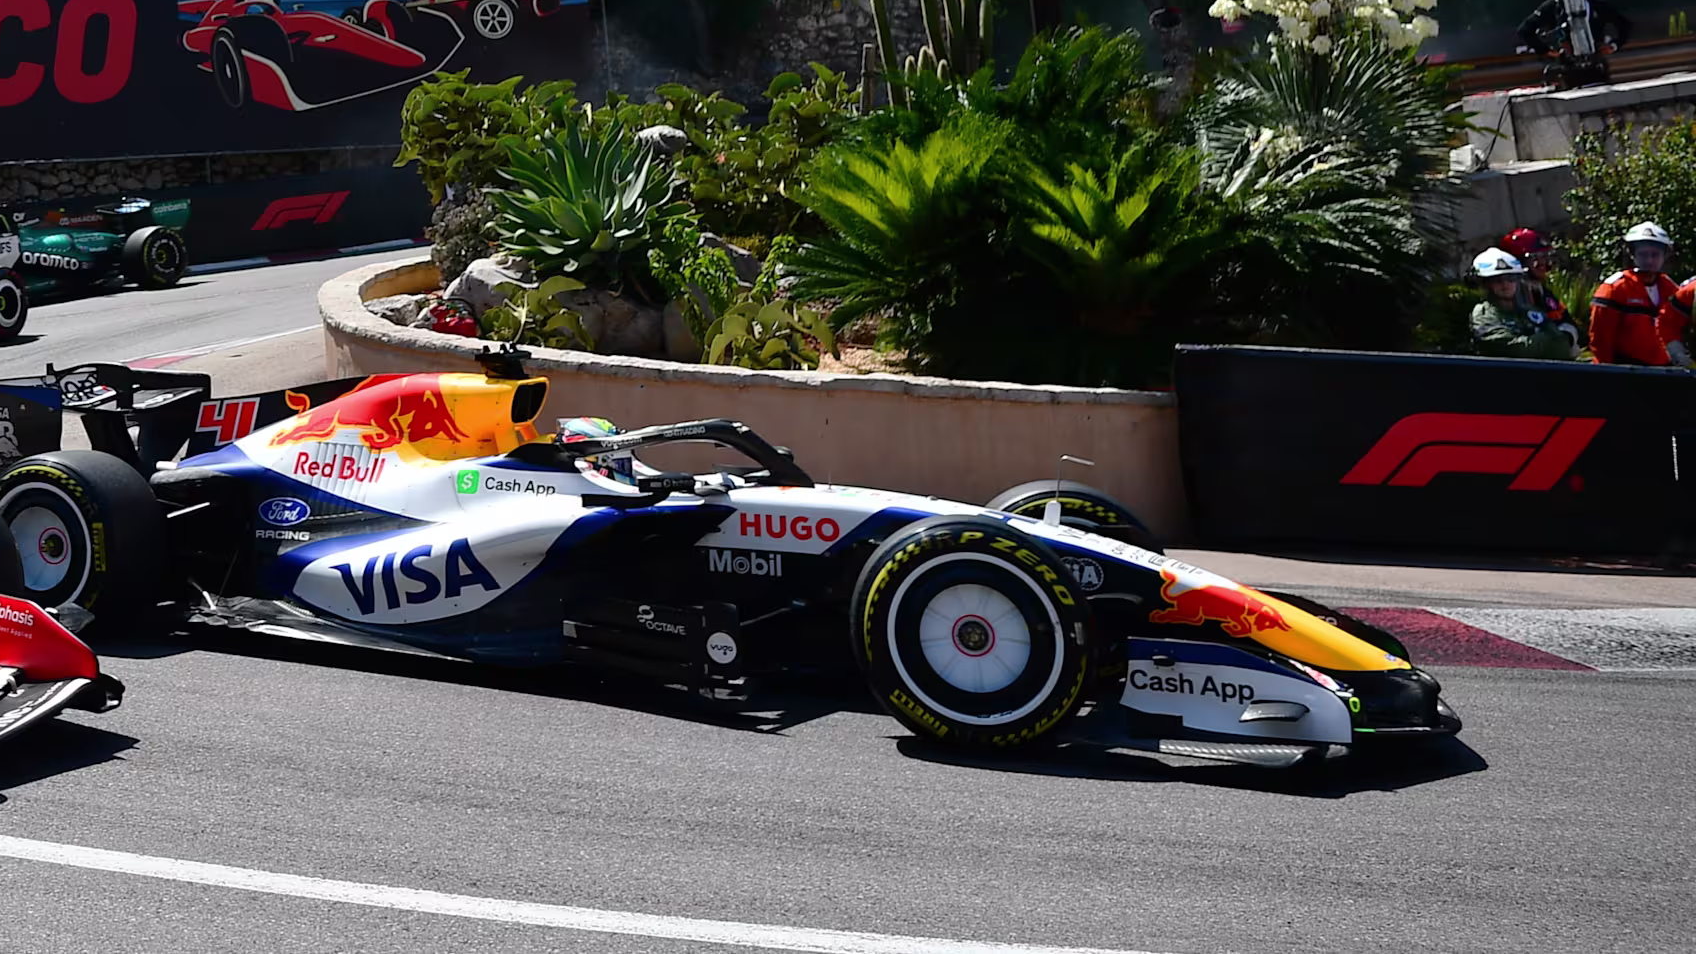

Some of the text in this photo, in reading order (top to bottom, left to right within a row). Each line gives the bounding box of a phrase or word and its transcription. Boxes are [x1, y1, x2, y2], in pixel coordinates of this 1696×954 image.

[22, 251, 80, 271] aramco
[195, 397, 260, 446] 41
[294, 452, 385, 484] Red Bull
[485, 476, 556, 498] Cash App
[267, 501, 300, 521] Ford
[255, 529, 311, 542] RACING
[740, 513, 841, 544] HUGO
[331, 538, 501, 616] VISA
[709, 548, 781, 578] Mobil
[960, 531, 984, 544] P
[990, 536, 1076, 606] ZERO
[646, 620, 688, 636] OCTAVE
[1130, 669, 1255, 704] Cash App
